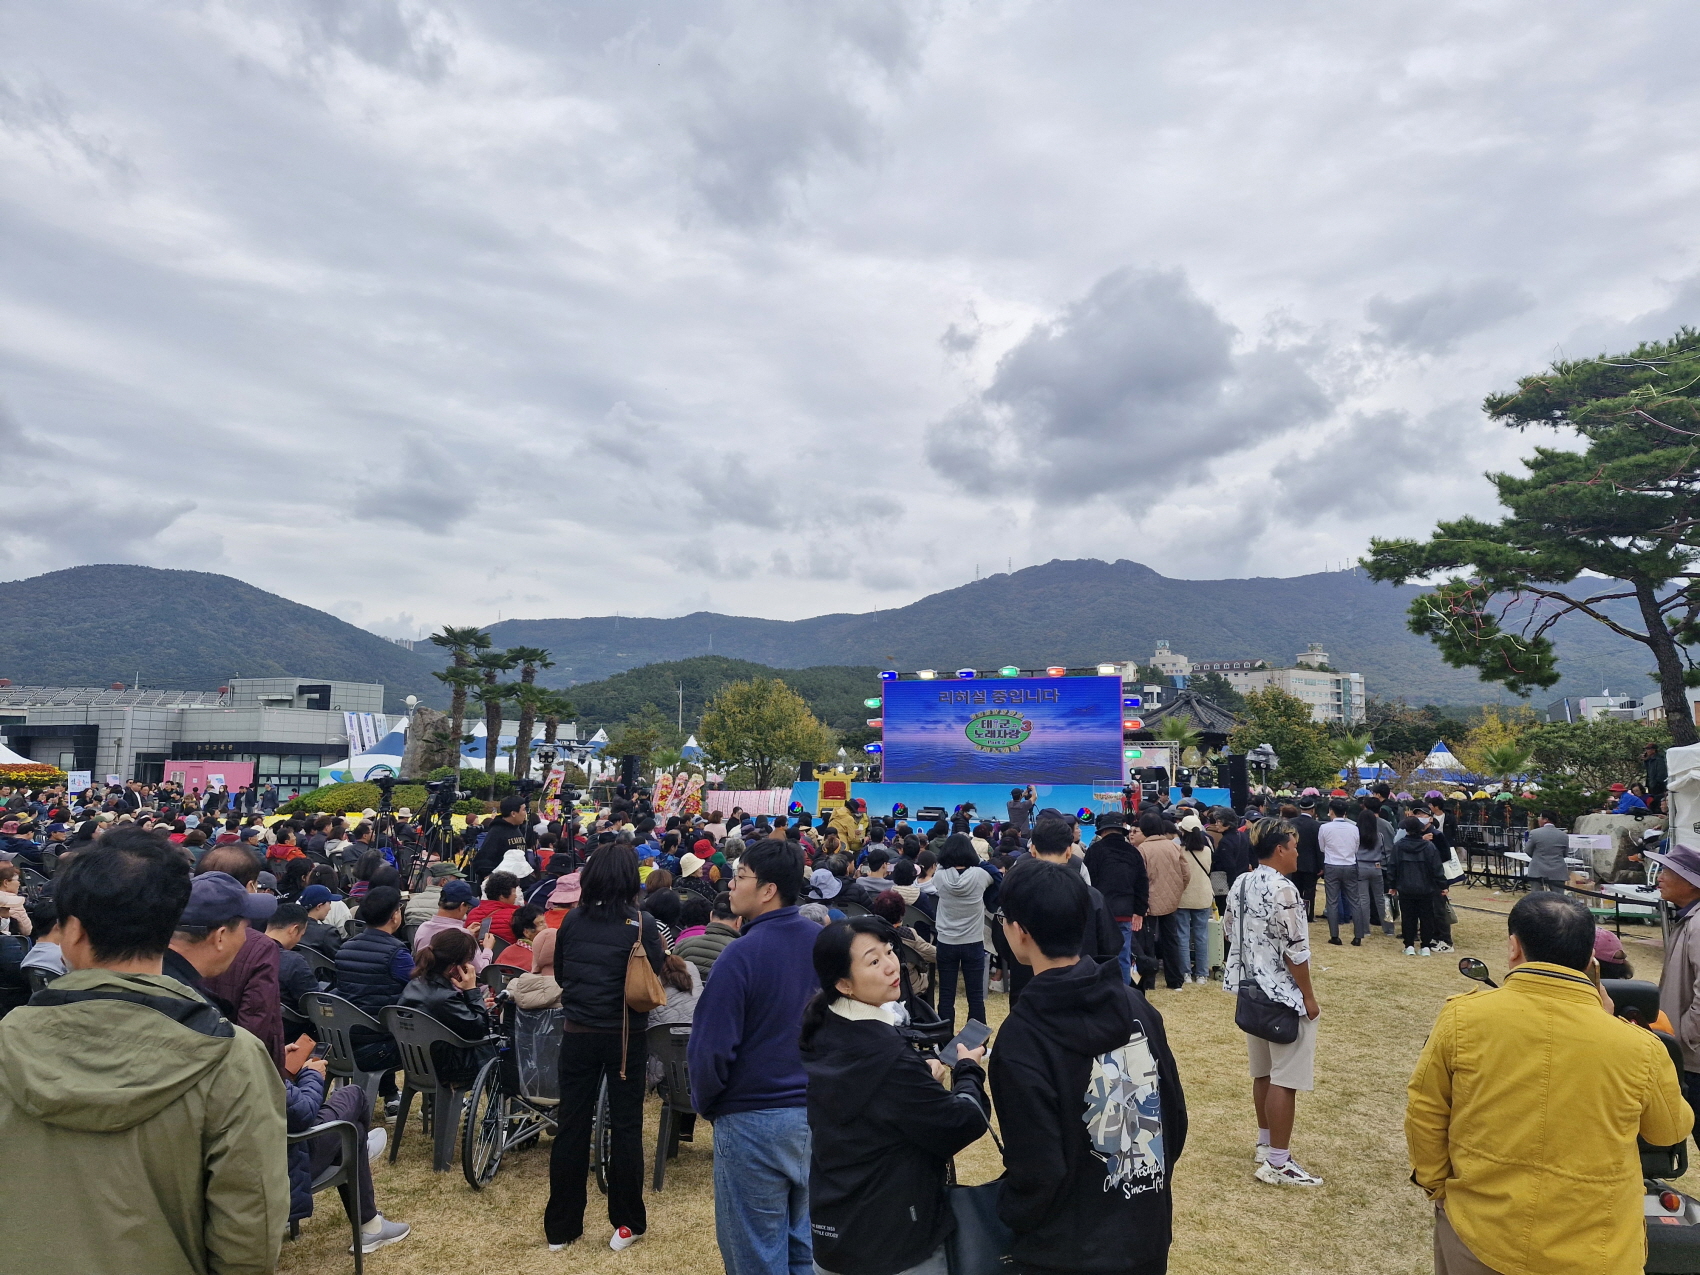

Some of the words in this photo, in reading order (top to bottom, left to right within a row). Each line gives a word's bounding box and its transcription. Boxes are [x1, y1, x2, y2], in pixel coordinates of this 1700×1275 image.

[938, 689, 987, 705] 리허설
[991, 687, 1061, 704] 중입니다
[1020, 720, 1033, 732] 3
[974, 729, 1021, 739] 노래자랑
[1122, 1182, 1148, 1199] Since
